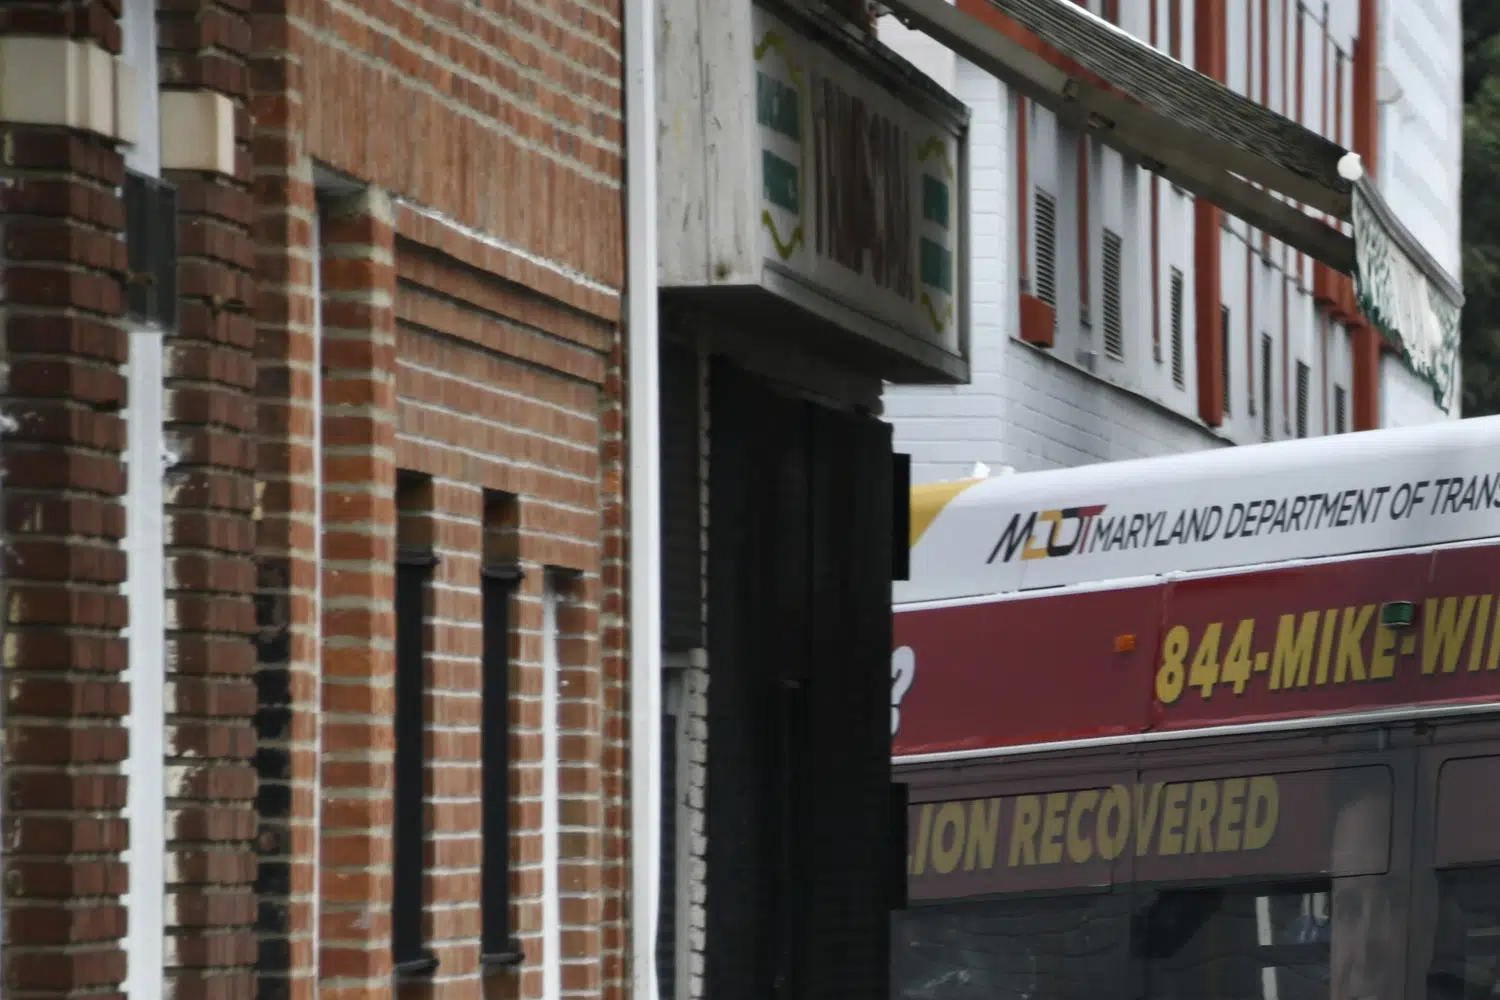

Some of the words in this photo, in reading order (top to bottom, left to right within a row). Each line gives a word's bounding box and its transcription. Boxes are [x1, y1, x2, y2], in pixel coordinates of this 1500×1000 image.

[1090, 505, 1224, 553] MARYLAND
[1223, 485, 1391, 540] DEPARTMENT
[1390, 480, 1431, 521] OF
[907, 798, 1000, 876] ION
[1007, 775, 1280, 868] RECOVERED
